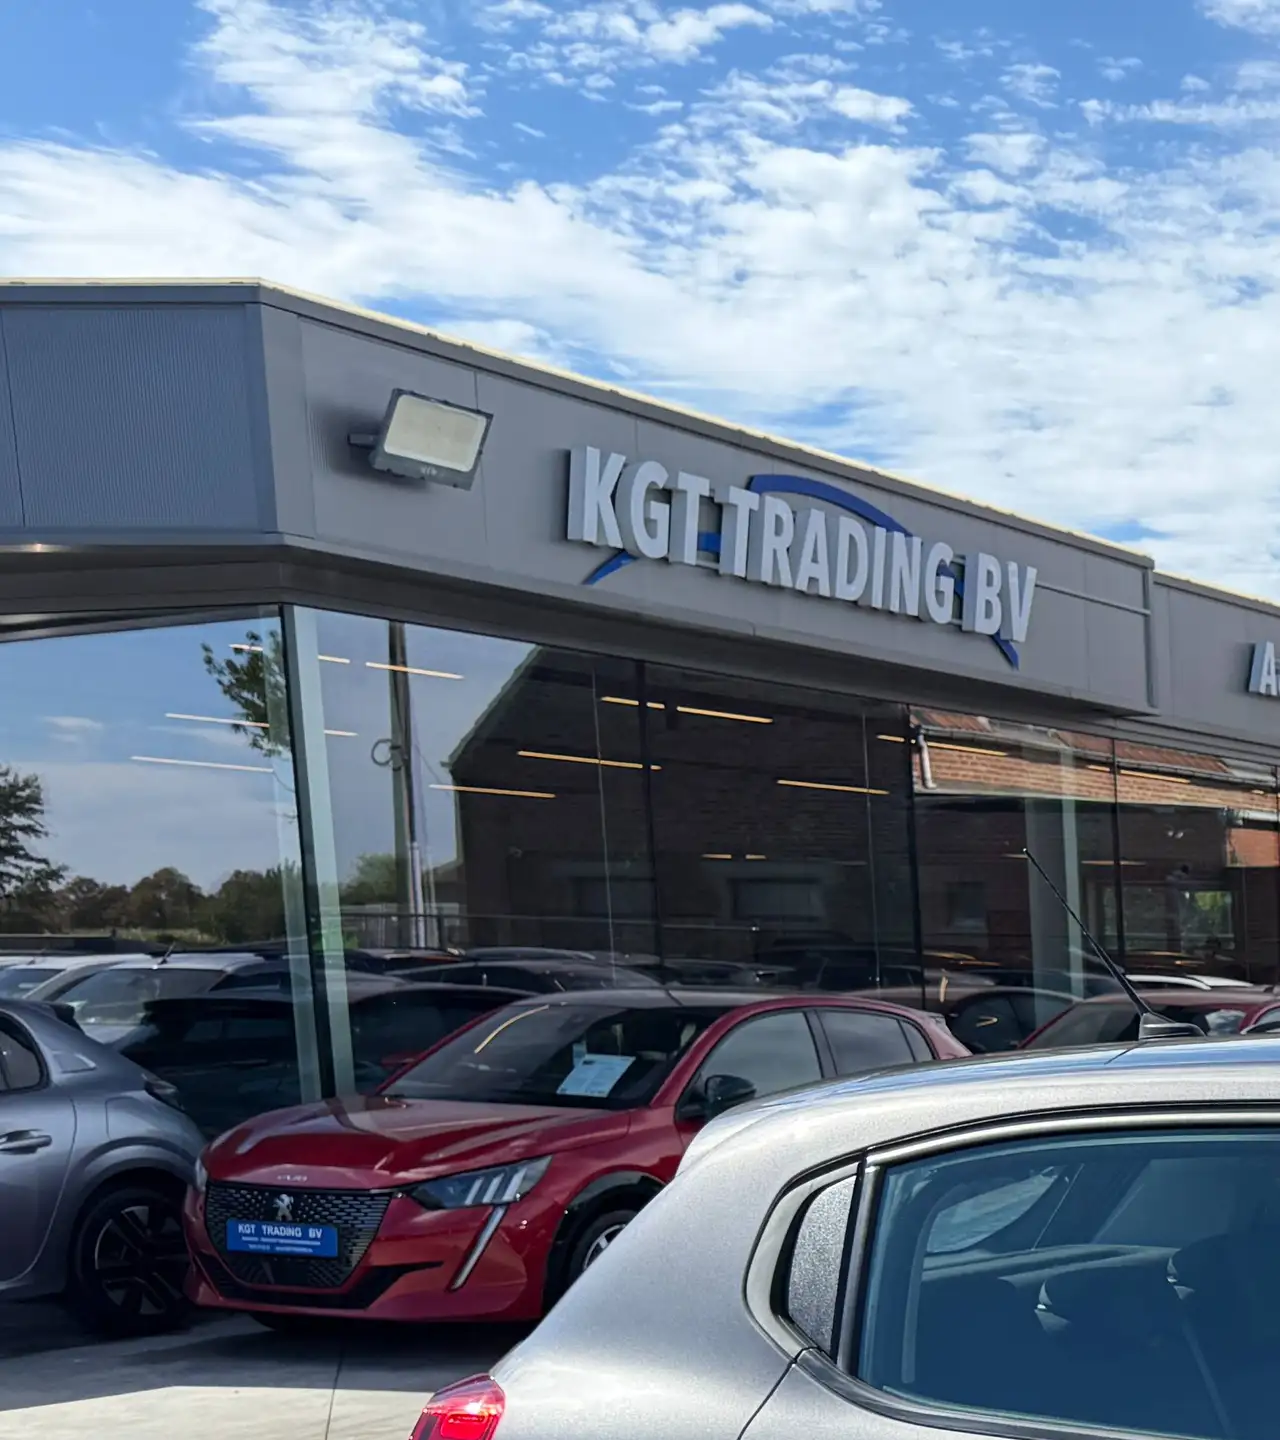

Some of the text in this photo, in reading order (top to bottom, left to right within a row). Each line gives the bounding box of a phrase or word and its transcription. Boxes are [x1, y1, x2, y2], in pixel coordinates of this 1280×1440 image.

[570, 445, 1037, 643] KGT TRADING BV
[238, 1223, 323, 1239] KGT TRADING BV
